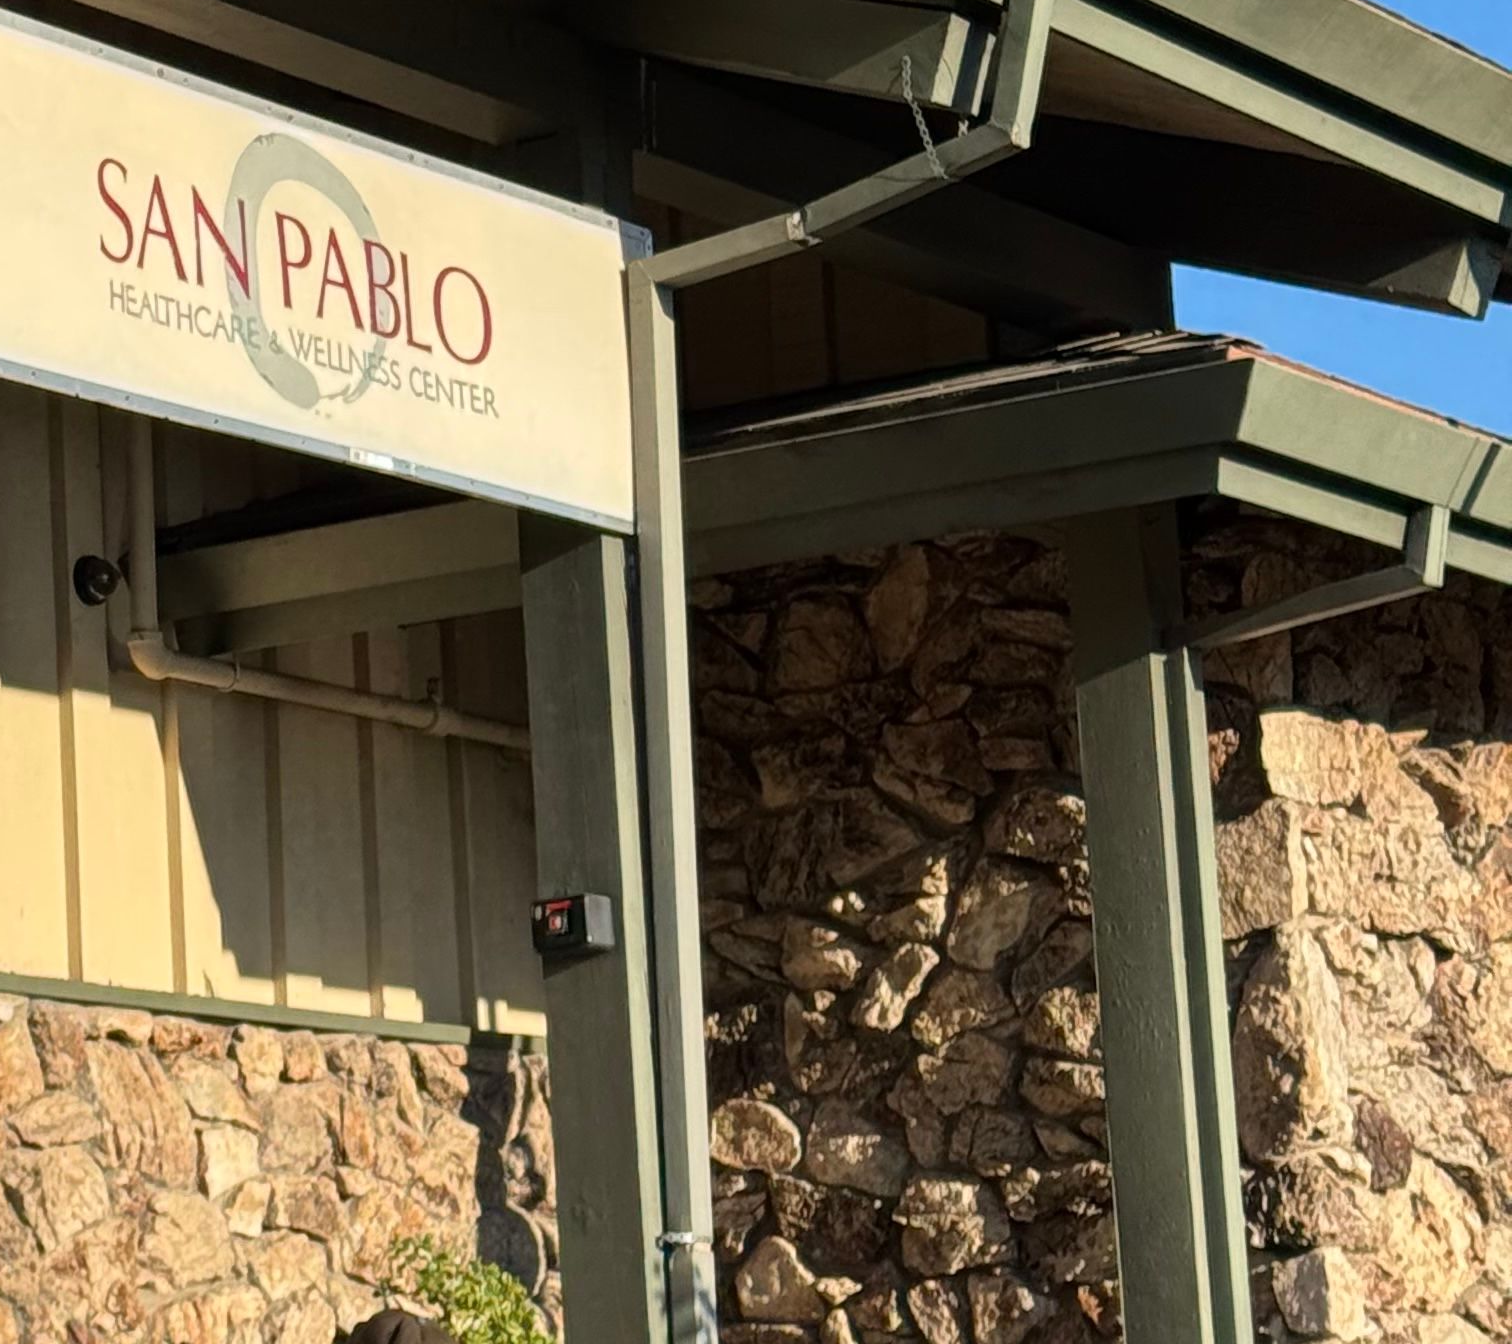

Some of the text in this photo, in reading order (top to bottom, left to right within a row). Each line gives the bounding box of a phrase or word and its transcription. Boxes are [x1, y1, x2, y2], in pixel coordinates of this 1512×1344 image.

[97, 158, 492, 365] SAN PABLO
[109, 279, 500, 419] HEALTHCARE & WELLNESS CENTER
